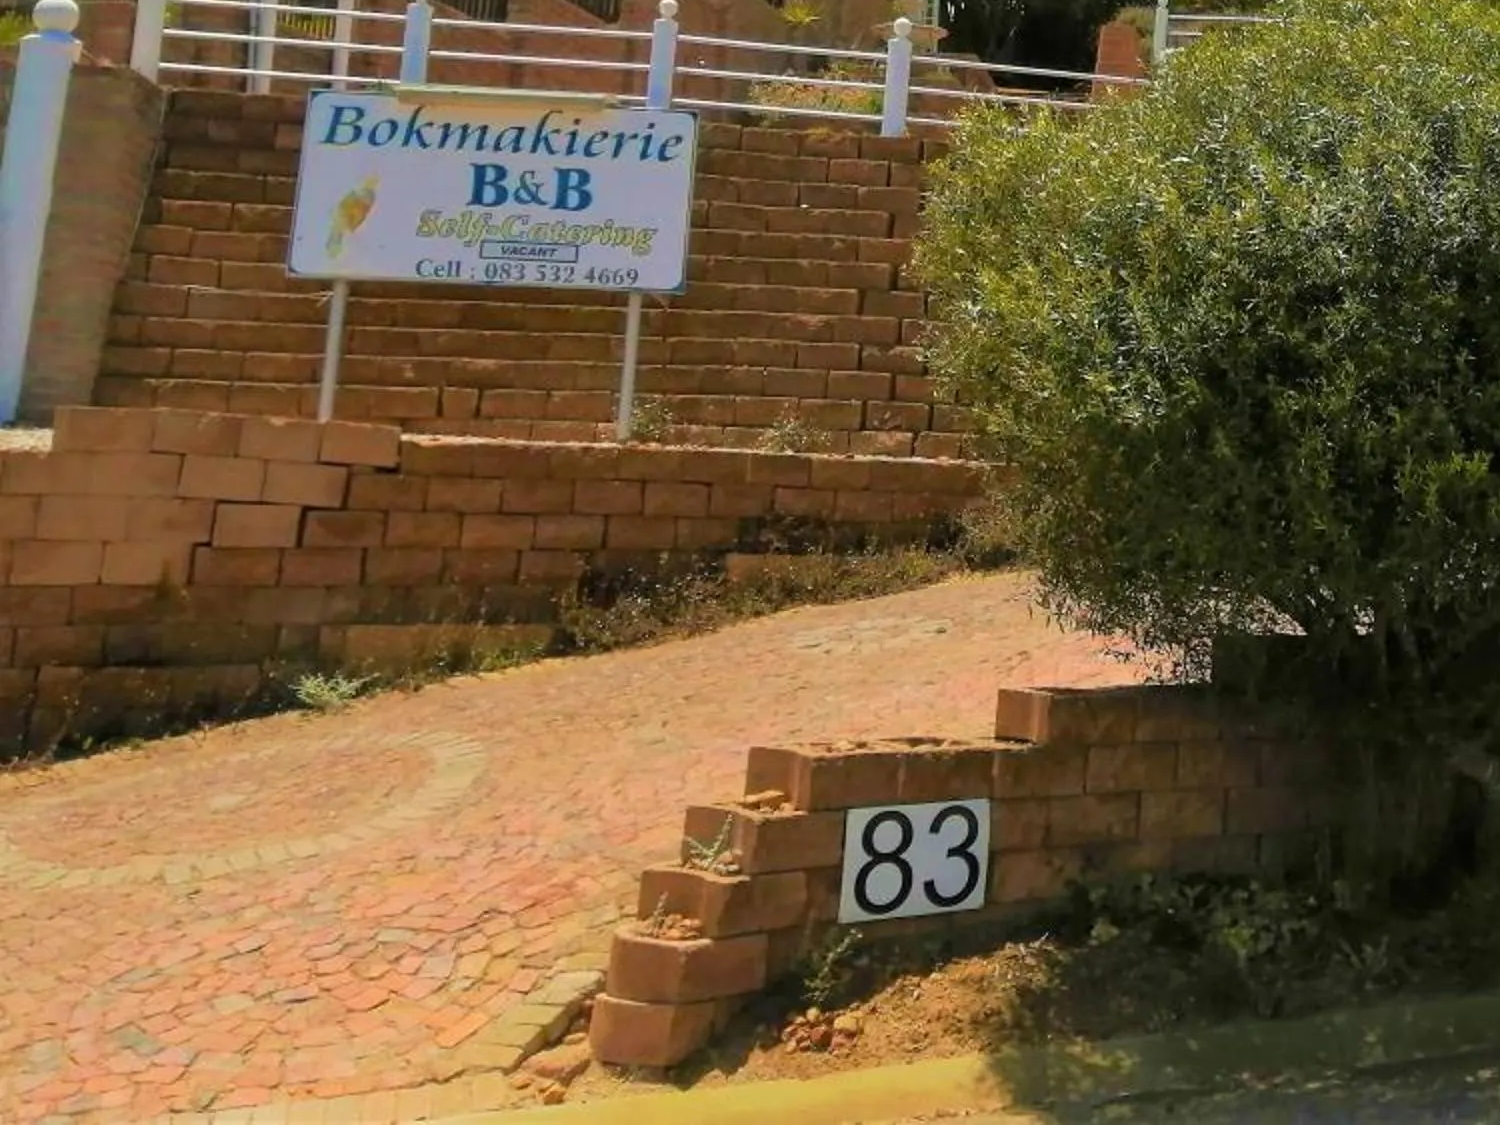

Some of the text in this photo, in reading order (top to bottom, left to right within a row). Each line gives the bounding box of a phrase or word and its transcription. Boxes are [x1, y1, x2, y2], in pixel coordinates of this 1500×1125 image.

[319, 104, 683, 162] Bokmakierie
[466, 162, 593, 212] B&B
[416, 209, 659, 256] Self-Catering
[500, 244, 558, 258] VACANT
[415, 258, 462, 279] Cell
[484, 262, 526, 282] 083
[583, 267, 640, 286] 4669
[854, 805, 980, 915] 83
